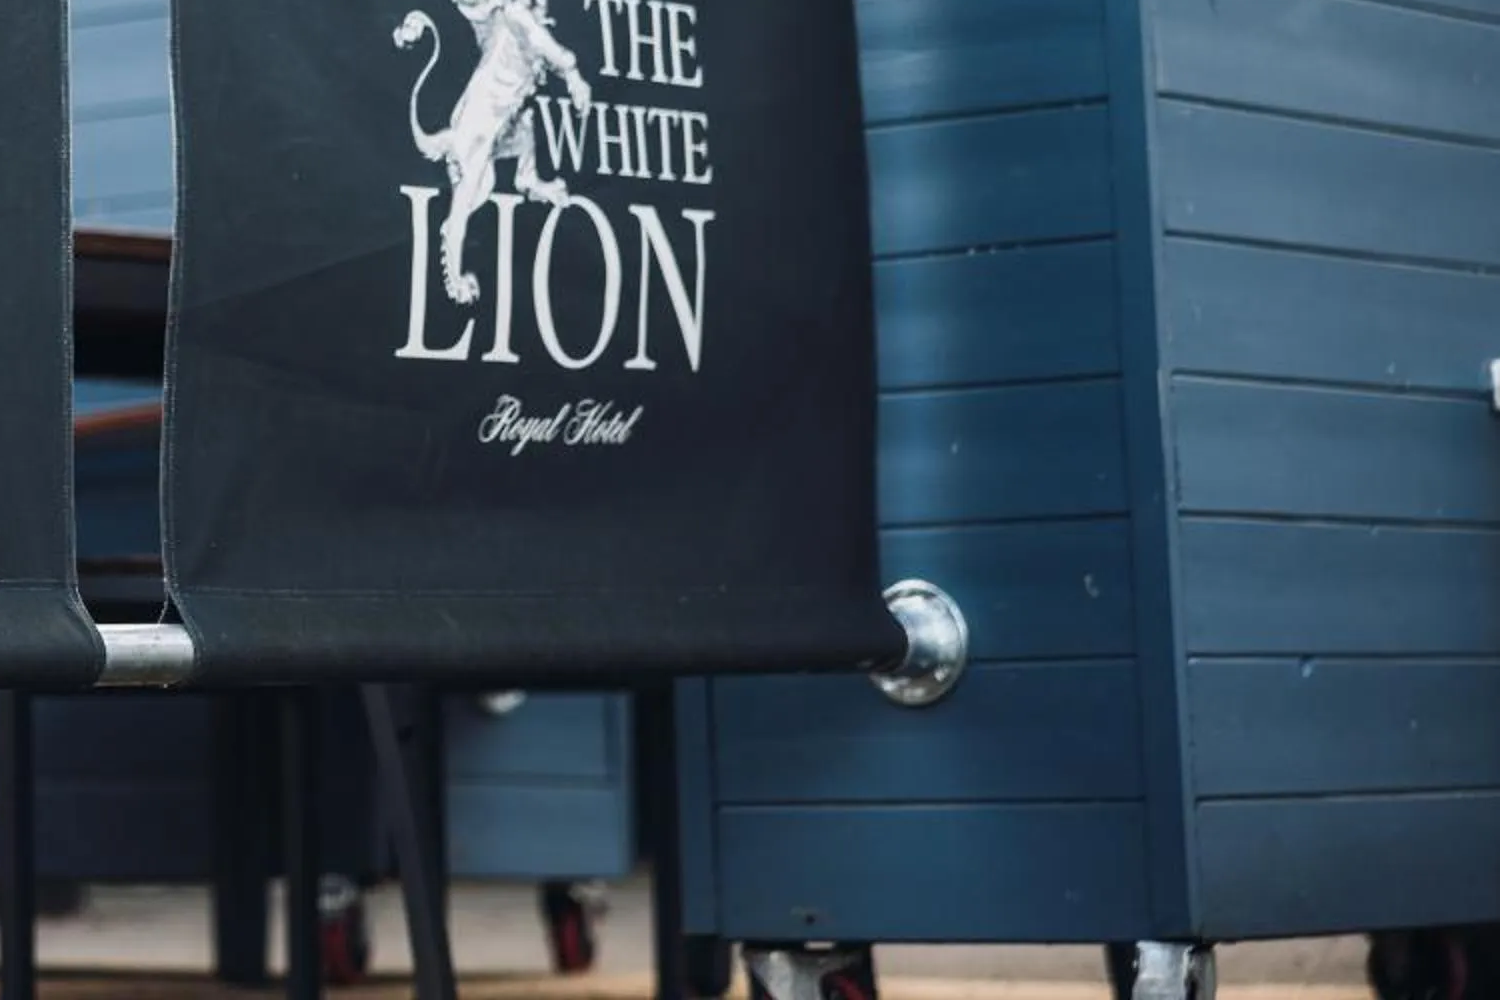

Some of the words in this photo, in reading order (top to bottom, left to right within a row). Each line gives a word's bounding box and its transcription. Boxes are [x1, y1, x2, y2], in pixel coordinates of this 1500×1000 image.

[534, 95, 714, 186] WHITE
[394, 184, 717, 373] LION
[478, 394, 571, 457] Royal
[564, 402, 644, 446] Hotel
